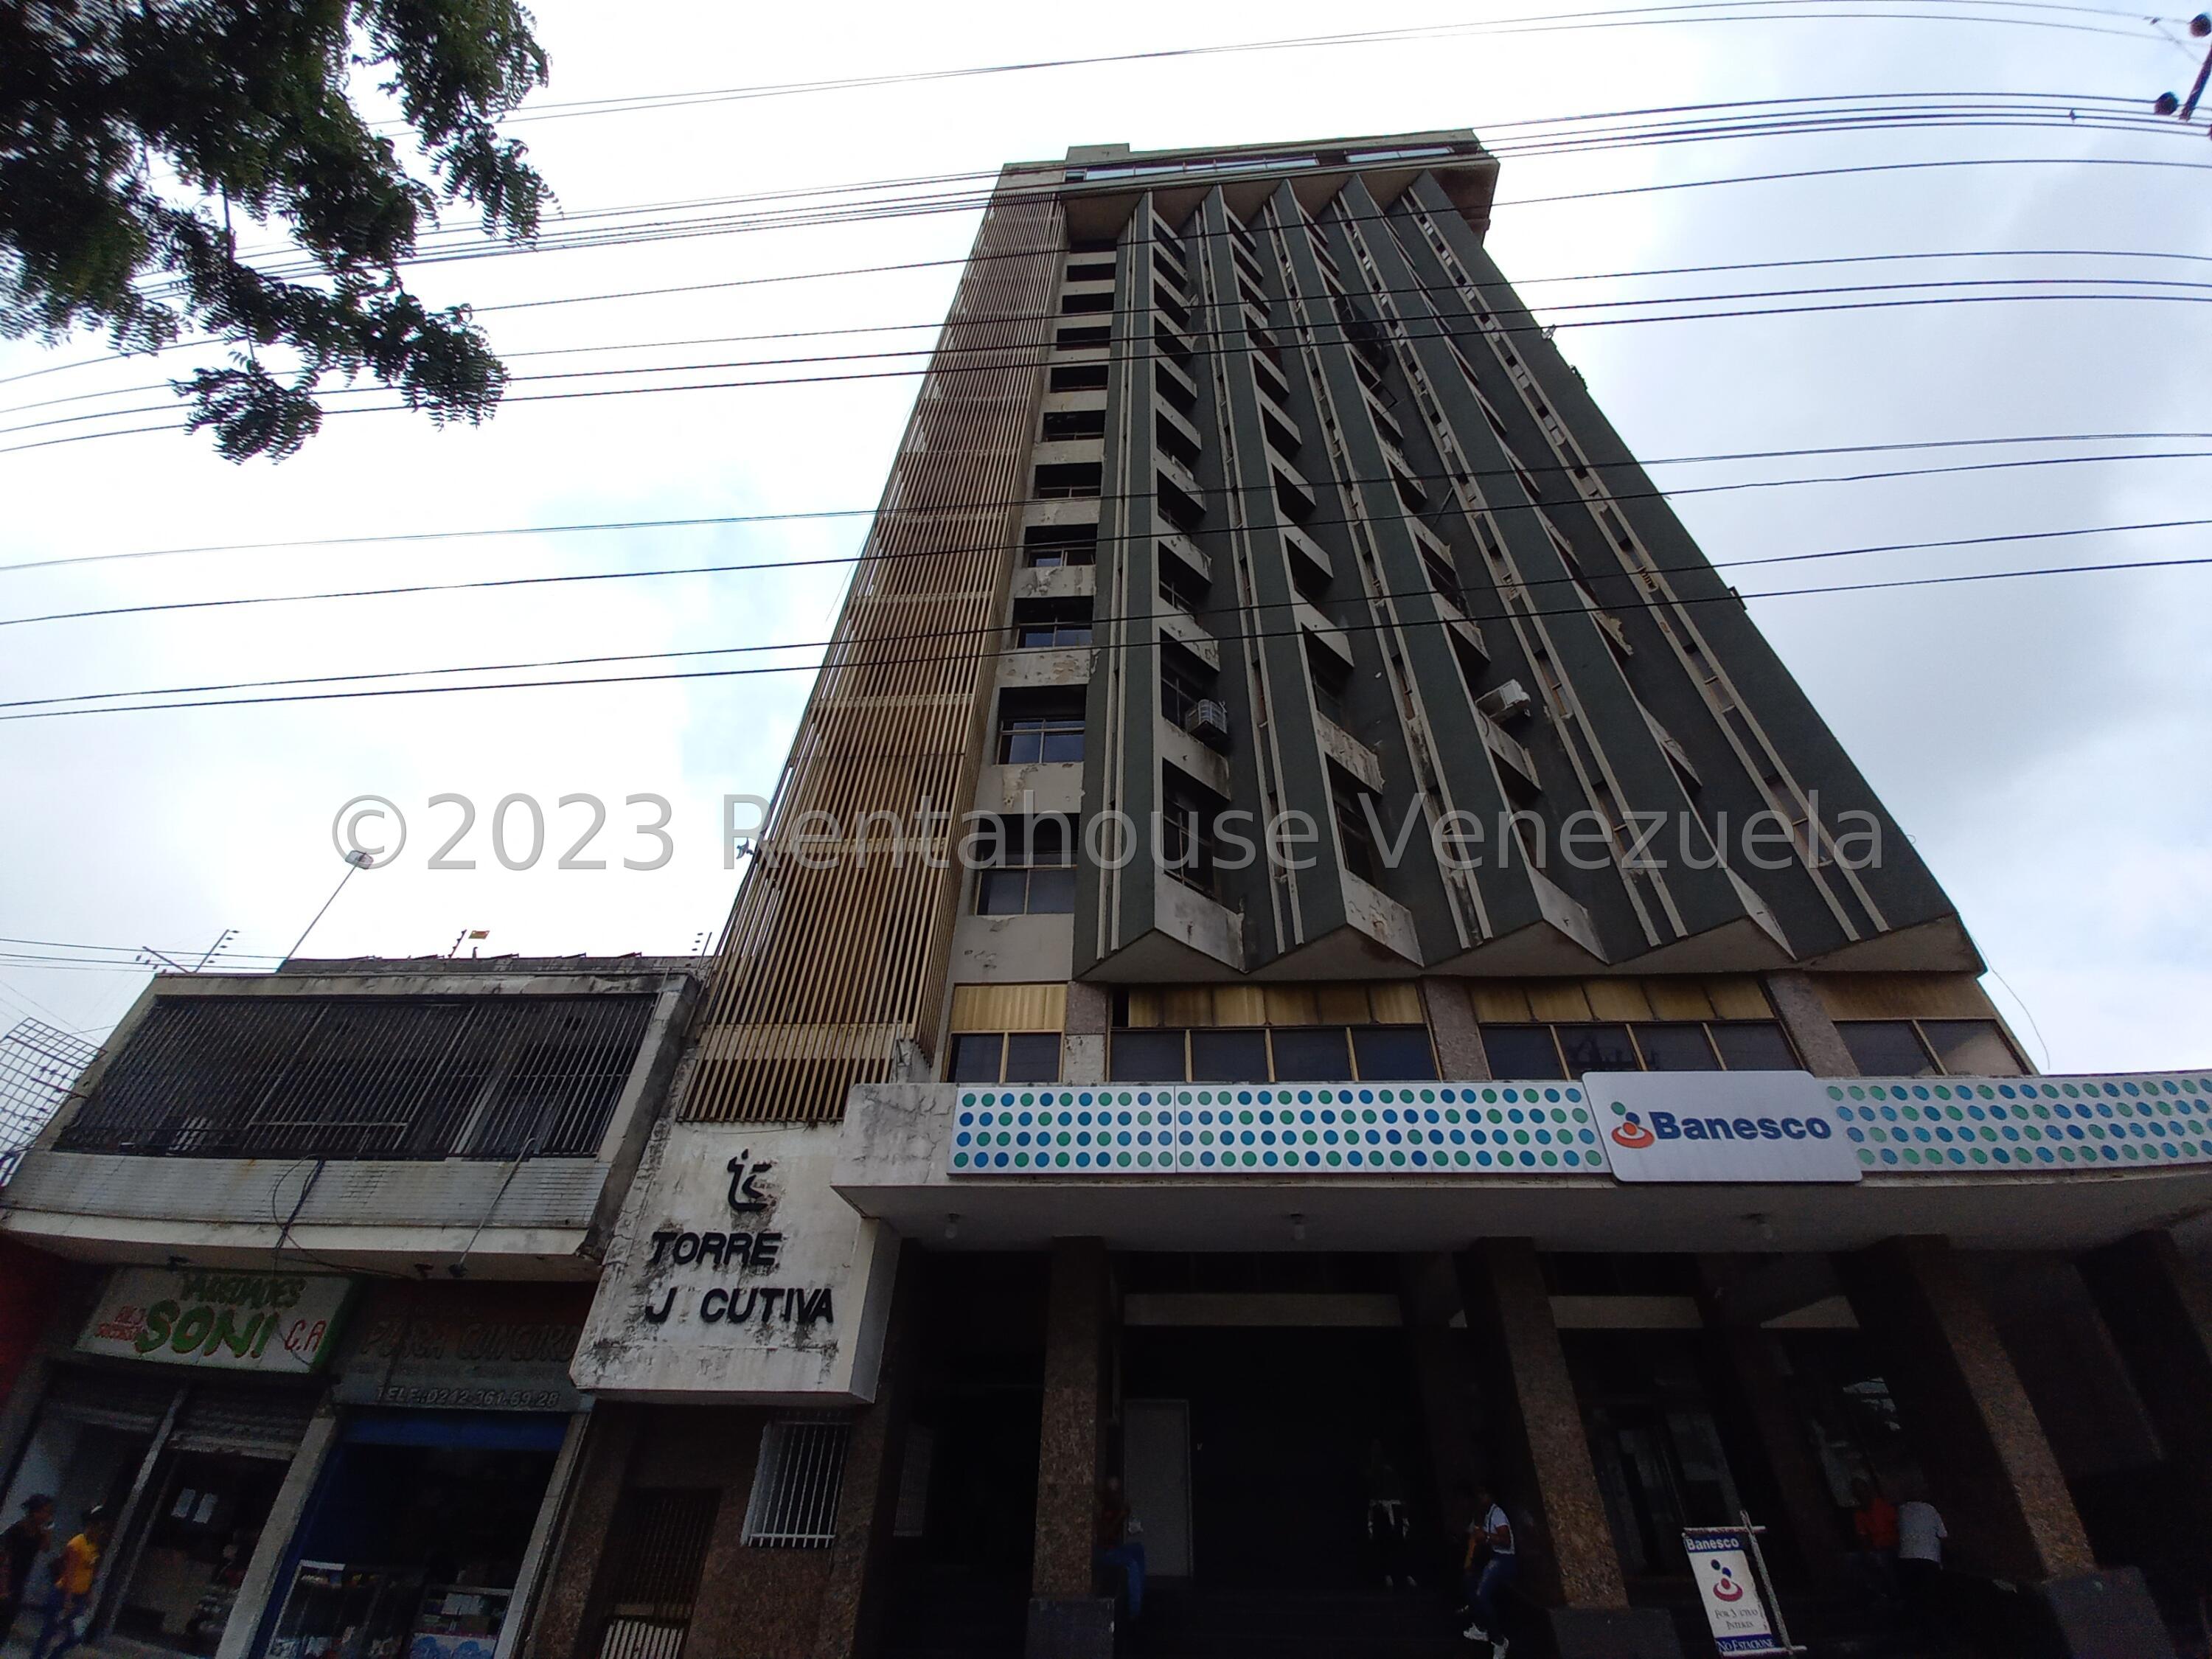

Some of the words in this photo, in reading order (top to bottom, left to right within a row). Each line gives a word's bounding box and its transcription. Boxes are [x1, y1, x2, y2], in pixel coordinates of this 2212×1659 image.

[1648, 1111, 1832, 1141] Banesco
[649, 1231, 783, 1267] TORRE
[644, 1287, 678, 1324] J
[700, 1287, 835, 1325] CUTIVA
[135, 1300, 280, 1357] SONI
[1686, 1538, 1739, 1550] Banesco
